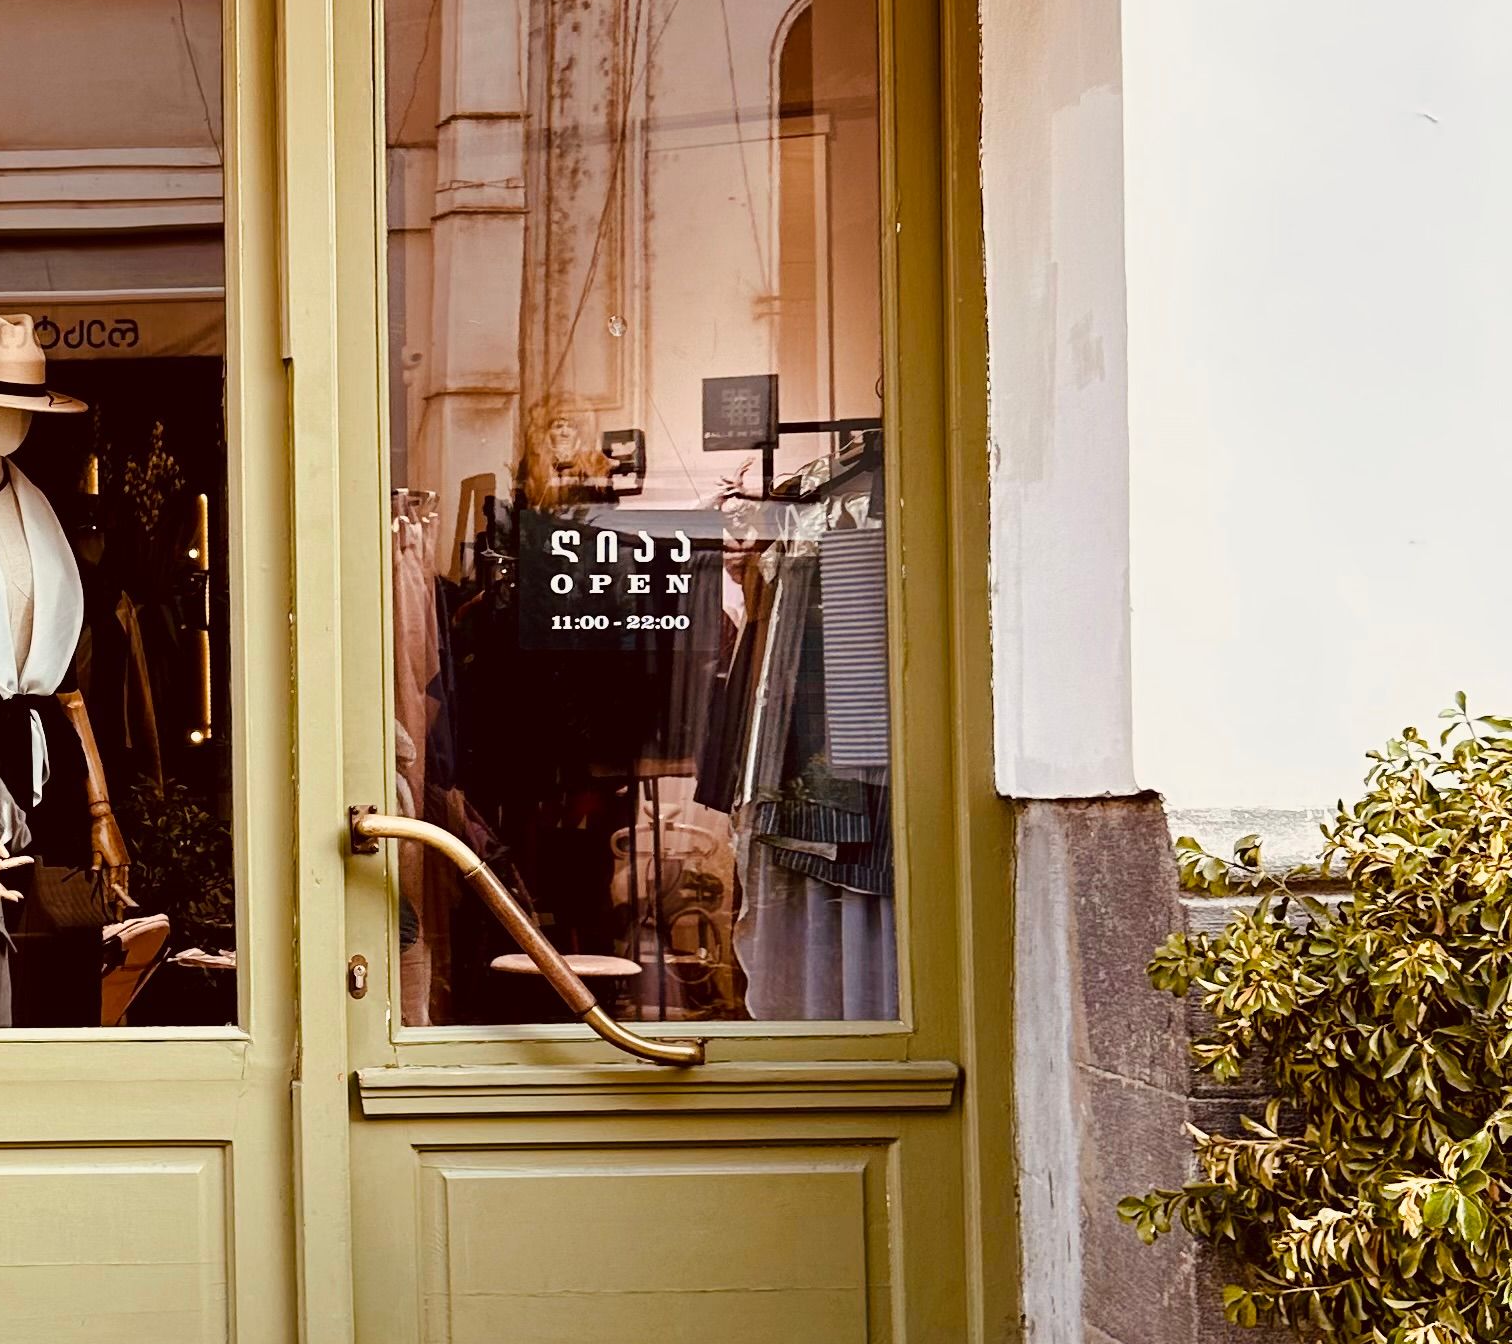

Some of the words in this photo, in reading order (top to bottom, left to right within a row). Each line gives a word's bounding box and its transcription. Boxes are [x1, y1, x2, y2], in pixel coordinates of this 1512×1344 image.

[550, 528, 692, 564] ღიაა
[550, 573, 692, 595] OPEN
[551, 615, 610, 630] 11:00
[626, 615, 690, 630] 22:00
